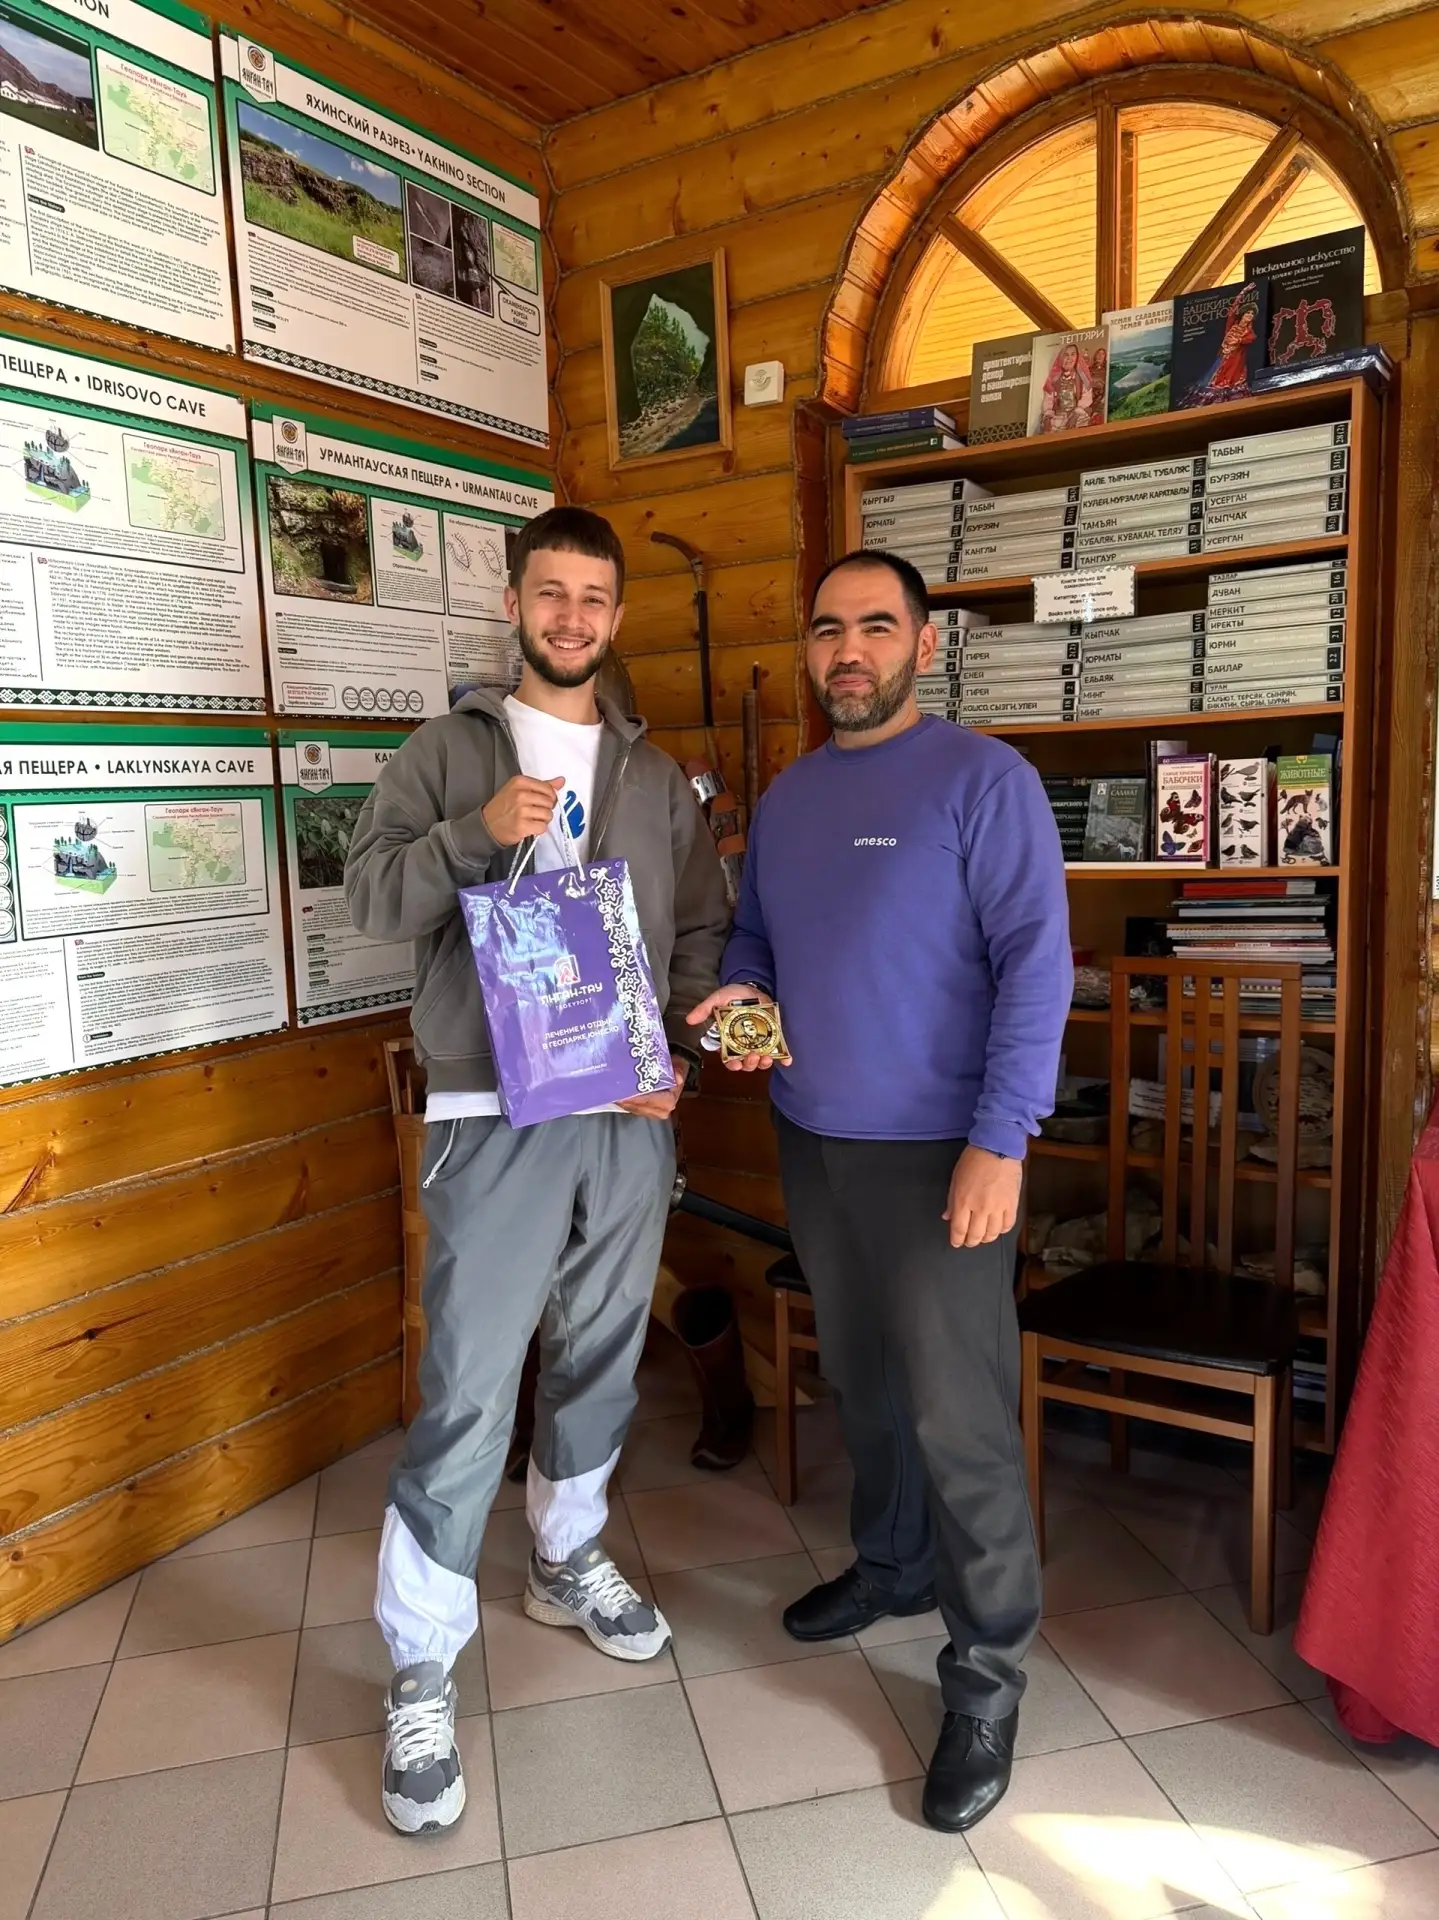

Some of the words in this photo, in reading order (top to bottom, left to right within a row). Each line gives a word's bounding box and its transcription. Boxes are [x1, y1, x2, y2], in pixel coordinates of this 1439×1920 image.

[306, 93, 370, 135] ЯХИНСКИЙ
[373, 126, 410, 155] РАЗРЕЗ
[417, 148, 464, 181] YAKHINO
[467, 173, 506, 203] SECTION
[1252, 258, 1305, 276] Наскальное
[1307, 246, 1356, 263] искусство
[1110, 316, 1131, 325] ЗЕМЛЯ
[1120, 321, 1142, 330] ЗЕМЛЯ
[1060, 329, 1105, 345] ТЕПТЯРИ
[0, 354, 67, 384] ПЕЩЕРА
[87, 375, 161, 406] IDRISOVO
[166, 395, 206, 417] CAVE
[1335, 424, 1346, 444] 28(2)
[1212, 446, 1244, 458] ТАБЫН
[1333, 451, 1342, 469] 31(2)
[320, 447, 409, 479] УРМАНТАУСКАЯ
[411, 469, 452, 489] ПЕЩЕРА
[1153, 465, 1190, 477] ТУБАЛЯС
[1209, 471, 1250, 484] БУРЗЯН
[462, 481, 512, 503] URMANTAU
[514, 493, 538, 508] CAVE
[863, 495, 895, 505] КЫРГЫЗ
[1210, 493, 1247, 506] УСЕРГАН
[969, 502, 995, 513] ТАБЫН
[866, 518, 896, 528] ЮРМАТЫ
[1208, 511, 1248, 525] КЫПЧАК
[966, 522, 1000, 532] БУРЗЯН
[1082, 518, 1117, 531] ТАМЪЯН
[1158, 526, 1184, 537] ТЕЛЯУ
[864, 537, 887, 546] КАТАЙ
[1207, 534, 1244, 546] УСЕРГАН
[965, 546, 997, 556] КАНГЛЫ
[1080, 553, 1117, 565] ТАНГАУР
[963, 566, 989, 575] ГАЙНА
[1213, 573, 1238, 581] ТАЗЛАР
[1333, 574, 1341, 584] 16
[1212, 587, 1241, 598] ДУВАН
[1332, 594, 1339, 603] 20
[1210, 606, 1245, 616] МЕРКИТ
[1332, 608, 1341, 618] 12
[1211, 620, 1244, 630] ИРЕКТЫ
[970, 630, 1003, 640] КЫПЧАК
[1085, 629, 1120, 640] КЫПЧАК
[1331, 630, 1340, 639] 21
[1209, 640, 1236, 650] ЮРМИ
[966, 652, 989, 661] ГИРЕЙ
[1070, 644, 1078, 658] 2(2)
[1085, 653, 1122, 663] ЮРМАТЫ
[1329, 653, 1338, 663] 22
[1208, 663, 1243, 674] БАЙЛАР
[1085, 674, 1114, 684] ЕЛЬДЯК
[918, 687, 948, 696] ТУБАЛЯС
[966, 688, 989, 697] ГИРЕЙ
[1084, 691, 1105, 699] МИНГ
[1328, 689, 1337, 698] 19
[1081, 708, 1103, 716] МИНГ
[19, 760, 88, 776] ПЕЩЕРА
[107, 760, 211, 773] LAKLYNSKAYA
[215, 760, 254, 773] CAVE
[1281, 768, 1326, 779] ЖИВОТНЫЕ
[1163, 776, 1203, 784] БАБОЧКИ
[854, 837, 897, 847] unesco
[545, 1025, 579, 1039] ЛЕЧЕНИЕ
[549, 1034, 587, 1049] ГЕОПАРКЕ
